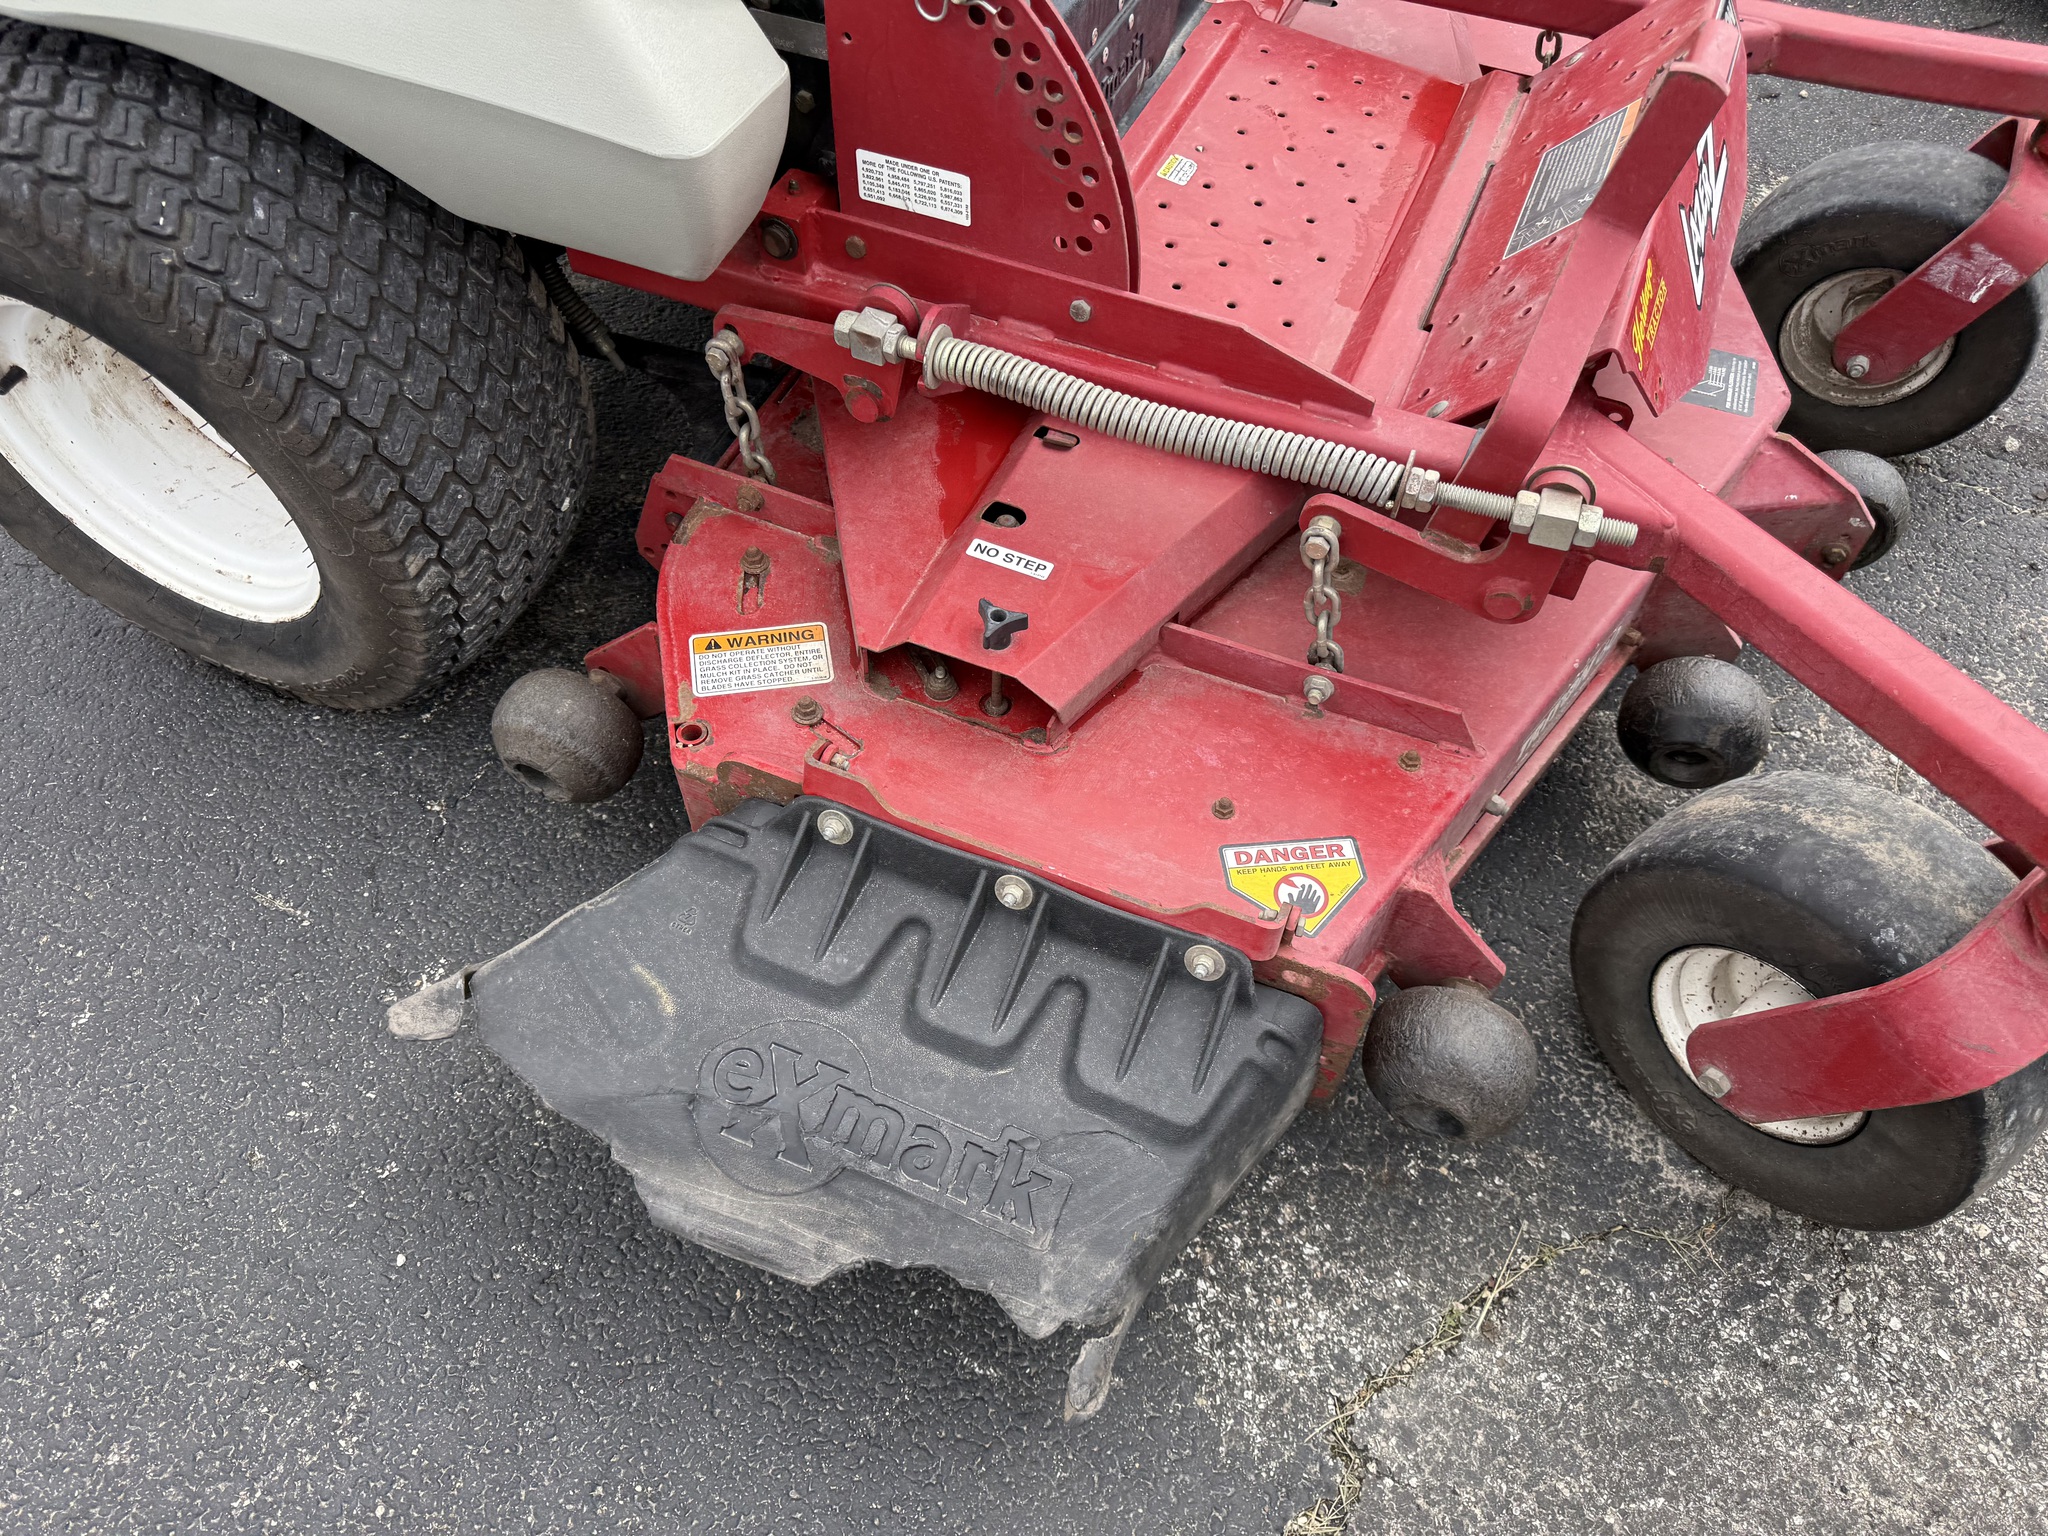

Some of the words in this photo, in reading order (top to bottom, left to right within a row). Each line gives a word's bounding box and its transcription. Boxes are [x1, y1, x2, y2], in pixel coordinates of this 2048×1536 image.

[862, 159, 876, 167] MORE
[898, 168, 926, 179] FOLLOWING
[885, 159, 899, 167] MADE
[901, 163, 918, 171] UNDER
[1646, 278, 1667, 348] TRACTOR
[974, 543, 999, 557] NO
[1003, 553, 1047, 572] STEP
[727, 630, 814, 648] WARNING
[699, 657, 743, 666] DISCHARGE
[795, 648, 821, 656] ENTIRE
[730, 649, 765, 657] OPERATE
[767, 645, 800, 653] WITHOUT
[728, 659, 777, 669] COLLECTION
[778, 655, 811, 664] SYSTEM,
[700, 671, 728, 679] MULCH
[753, 665, 780, 673] PLACE.
[701, 677, 733, 685] REMOVE
[764, 669, 800, 678] CATCHER
[802, 666, 823, 674] UNTIL
[701, 683, 732, 691] BLADES
[757, 676, 796, 685] STOPPED.
[1234, 844, 1346, 865] DANGER
[1260, 866, 1287, 874] HANDS
[1328, 860, 1352, 868] AWAY
[713, 1042, 1052, 1234] eXmark
